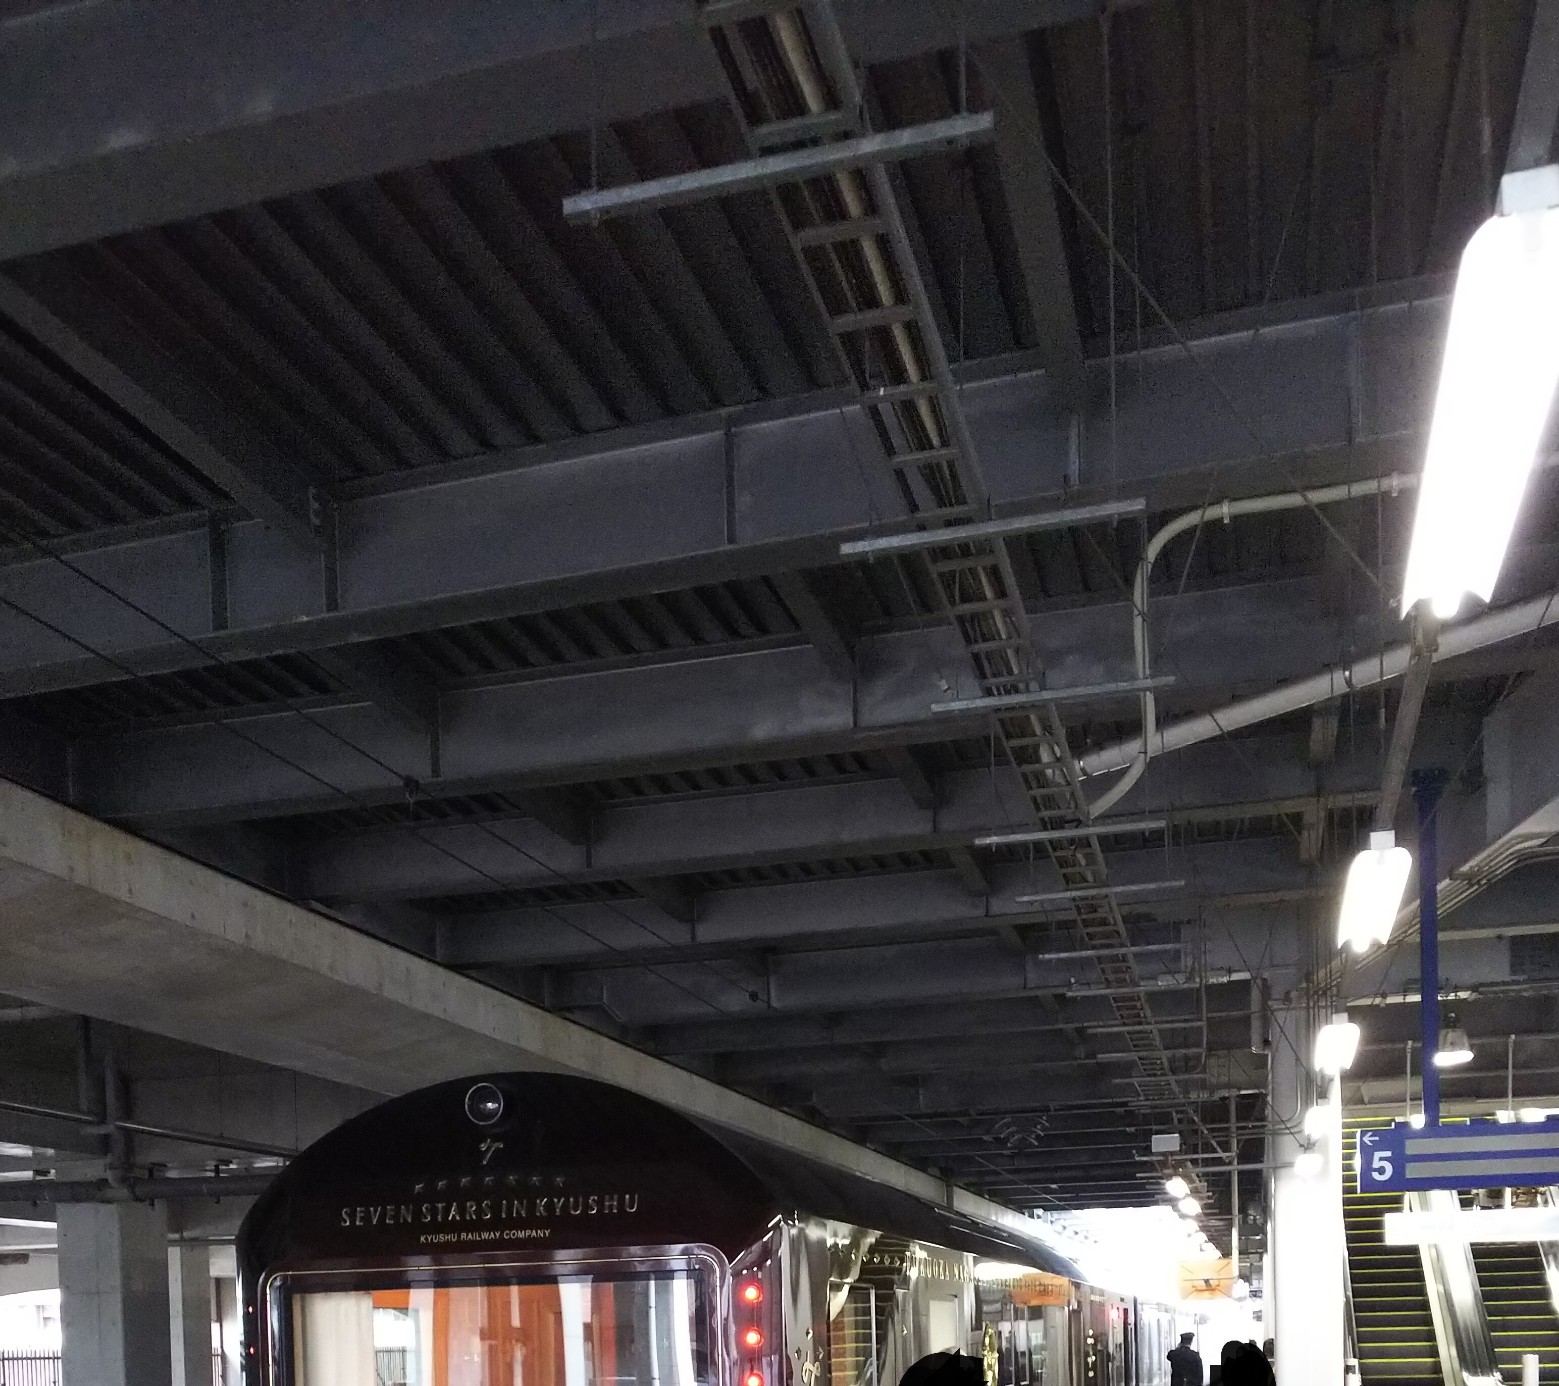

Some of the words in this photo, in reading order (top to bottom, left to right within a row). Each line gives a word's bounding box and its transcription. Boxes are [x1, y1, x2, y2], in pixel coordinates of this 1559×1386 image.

[1371, 1150, 1393, 1181] 5
[341, 1204, 413, 1226] SEVEN
[421, 1200, 491, 1222] STARS
[501, 1199, 527, 1218] IN
[535, 1193, 639, 1216] KYUSHU
[420, 1232, 458, 1243] KYUSHU
[461, 1231, 500, 1241] RAILWAY
[503, 1229, 550, 1240] COMPANY
